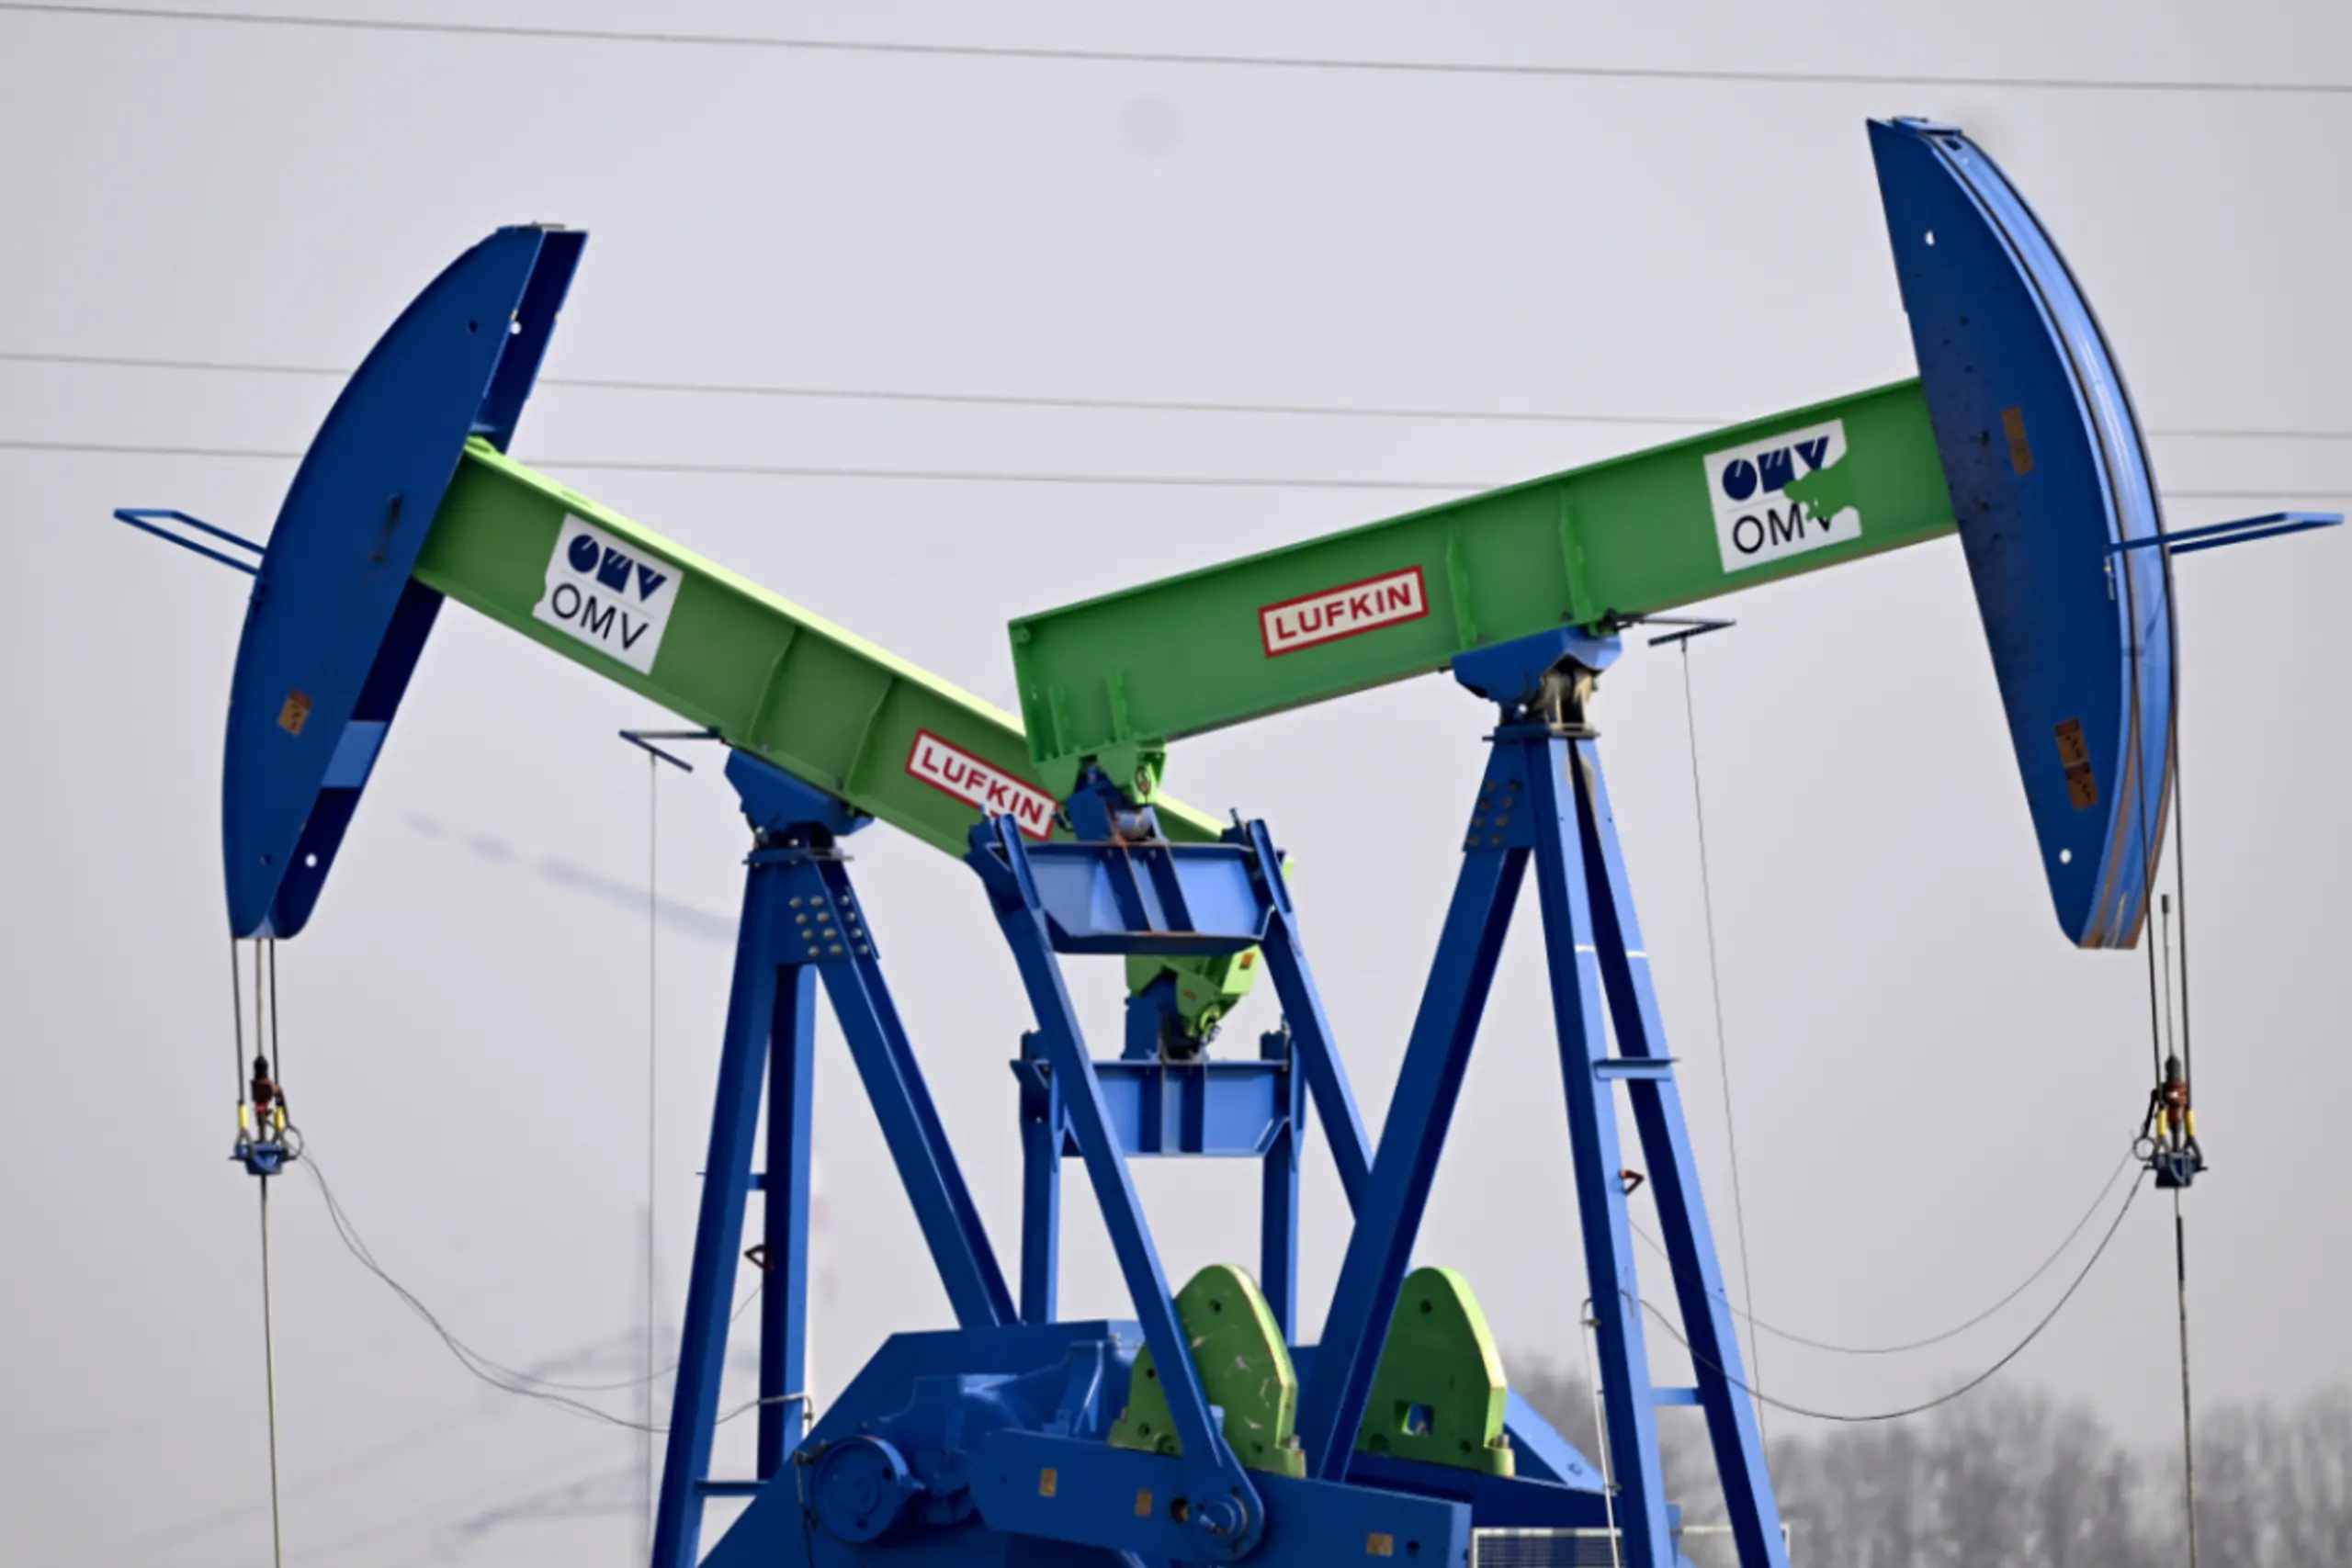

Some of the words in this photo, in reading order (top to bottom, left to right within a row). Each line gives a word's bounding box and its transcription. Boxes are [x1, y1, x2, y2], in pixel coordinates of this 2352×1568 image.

[552, 581, 650, 652] OMV
[1275, 582, 1412, 641] LUFKIN
[922, 745, 1044, 825] LUFKIN
